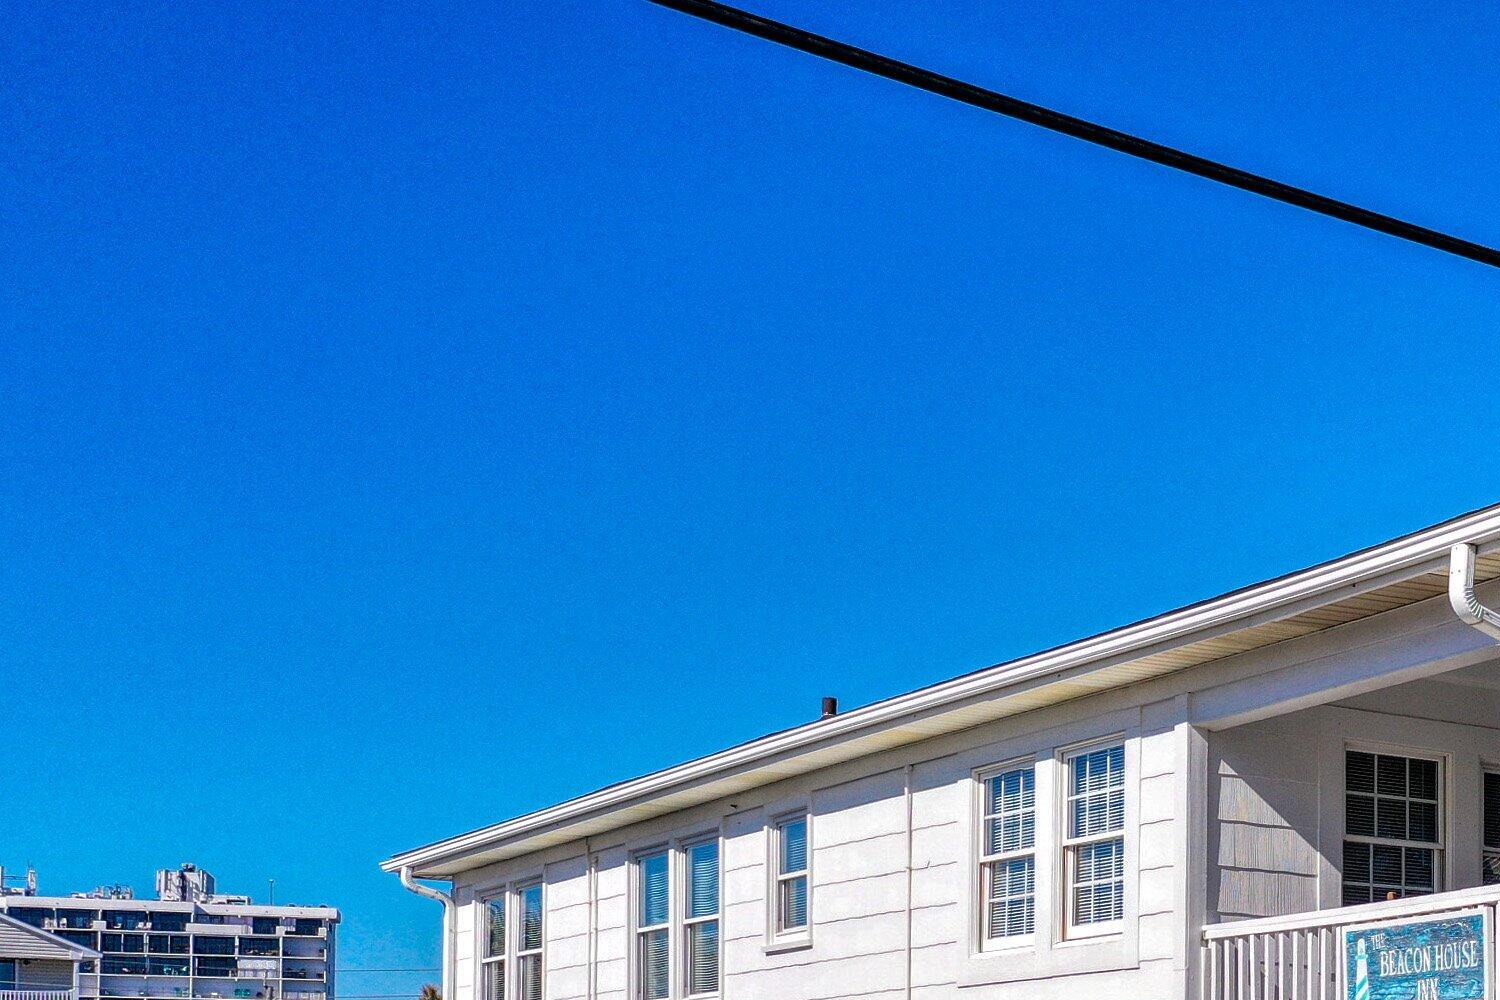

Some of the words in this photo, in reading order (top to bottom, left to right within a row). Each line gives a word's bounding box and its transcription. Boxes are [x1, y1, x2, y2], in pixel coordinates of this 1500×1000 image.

[1371, 933, 1386, 950] THE
[1380, 946, 1431, 976] BEACON
[1435, 941, 1478, 970] HOUSE
